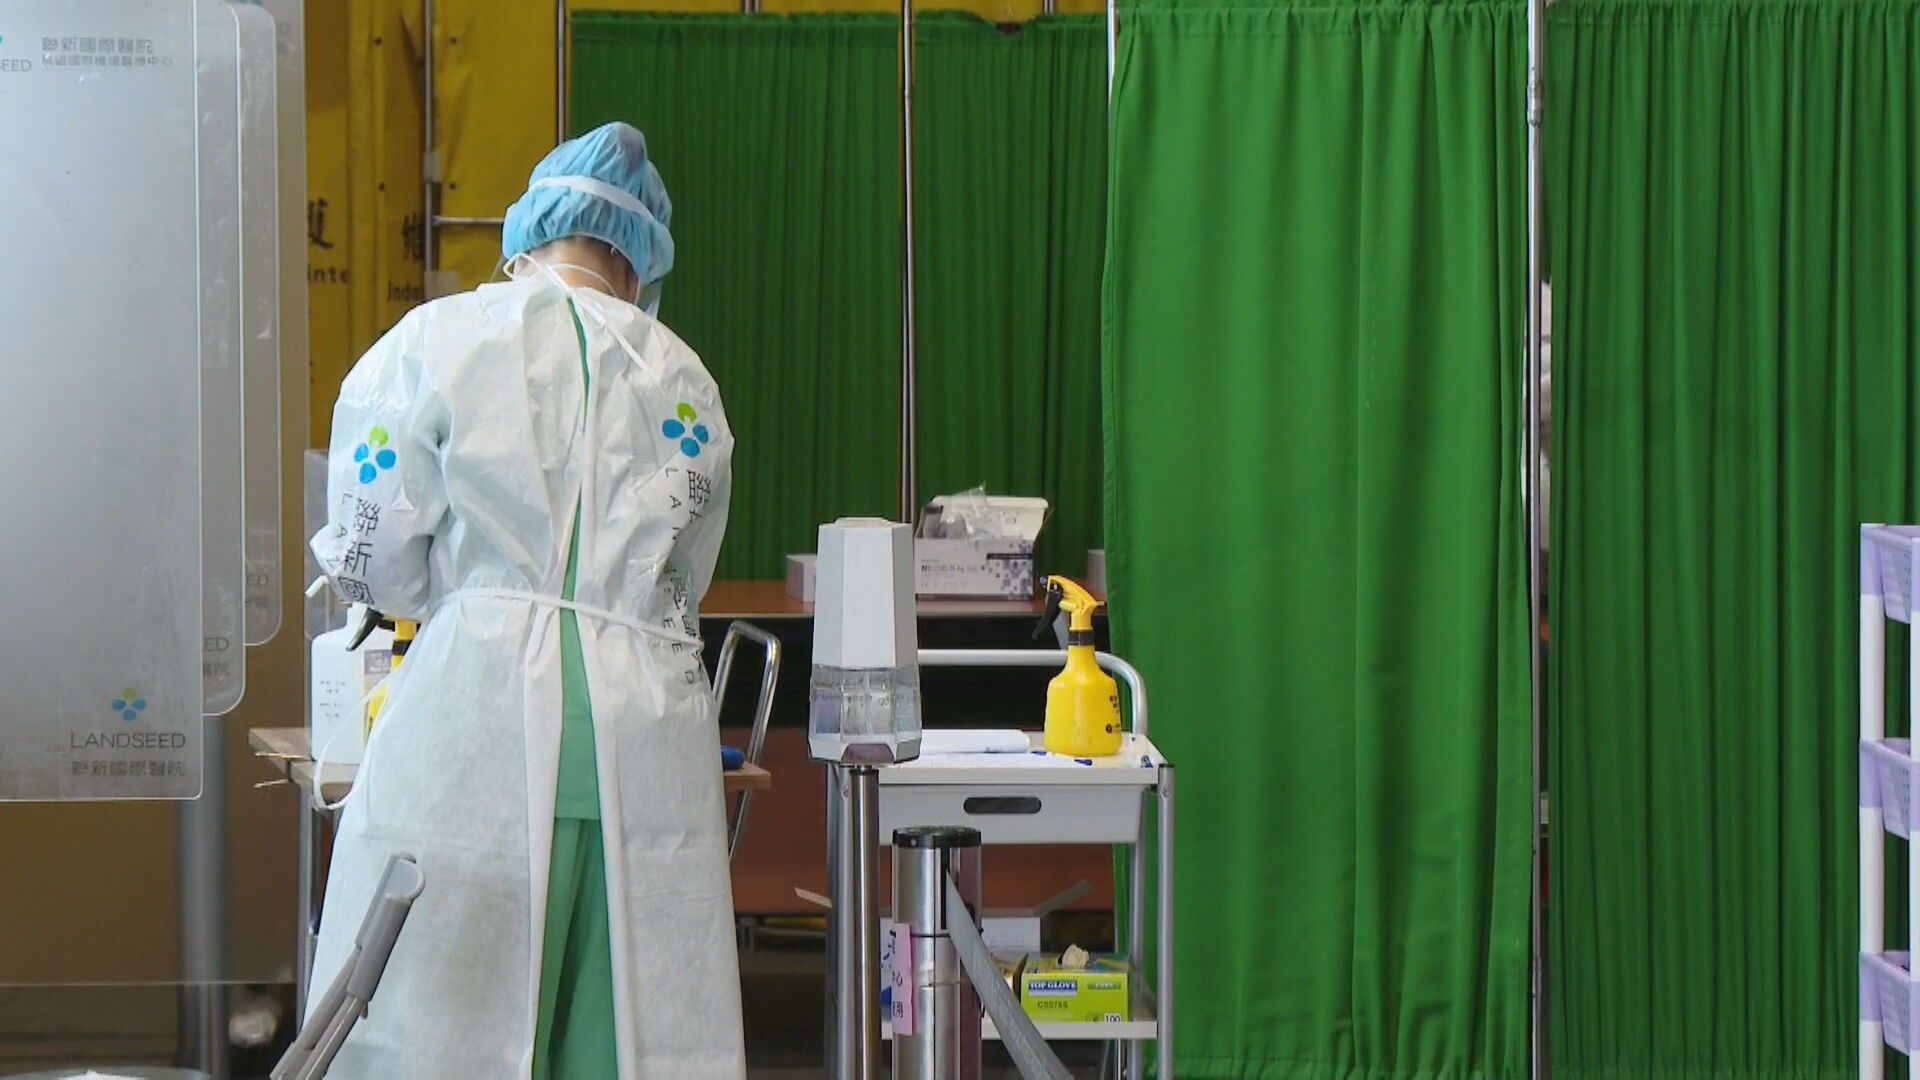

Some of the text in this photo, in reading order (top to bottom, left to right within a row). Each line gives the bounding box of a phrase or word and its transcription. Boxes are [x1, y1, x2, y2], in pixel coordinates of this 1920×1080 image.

[70, 732, 186, 748] LANDSEED
[1030, 980, 1077, 990] TOP GLOVE
[1105, 1015, 1121, 1024] 100
